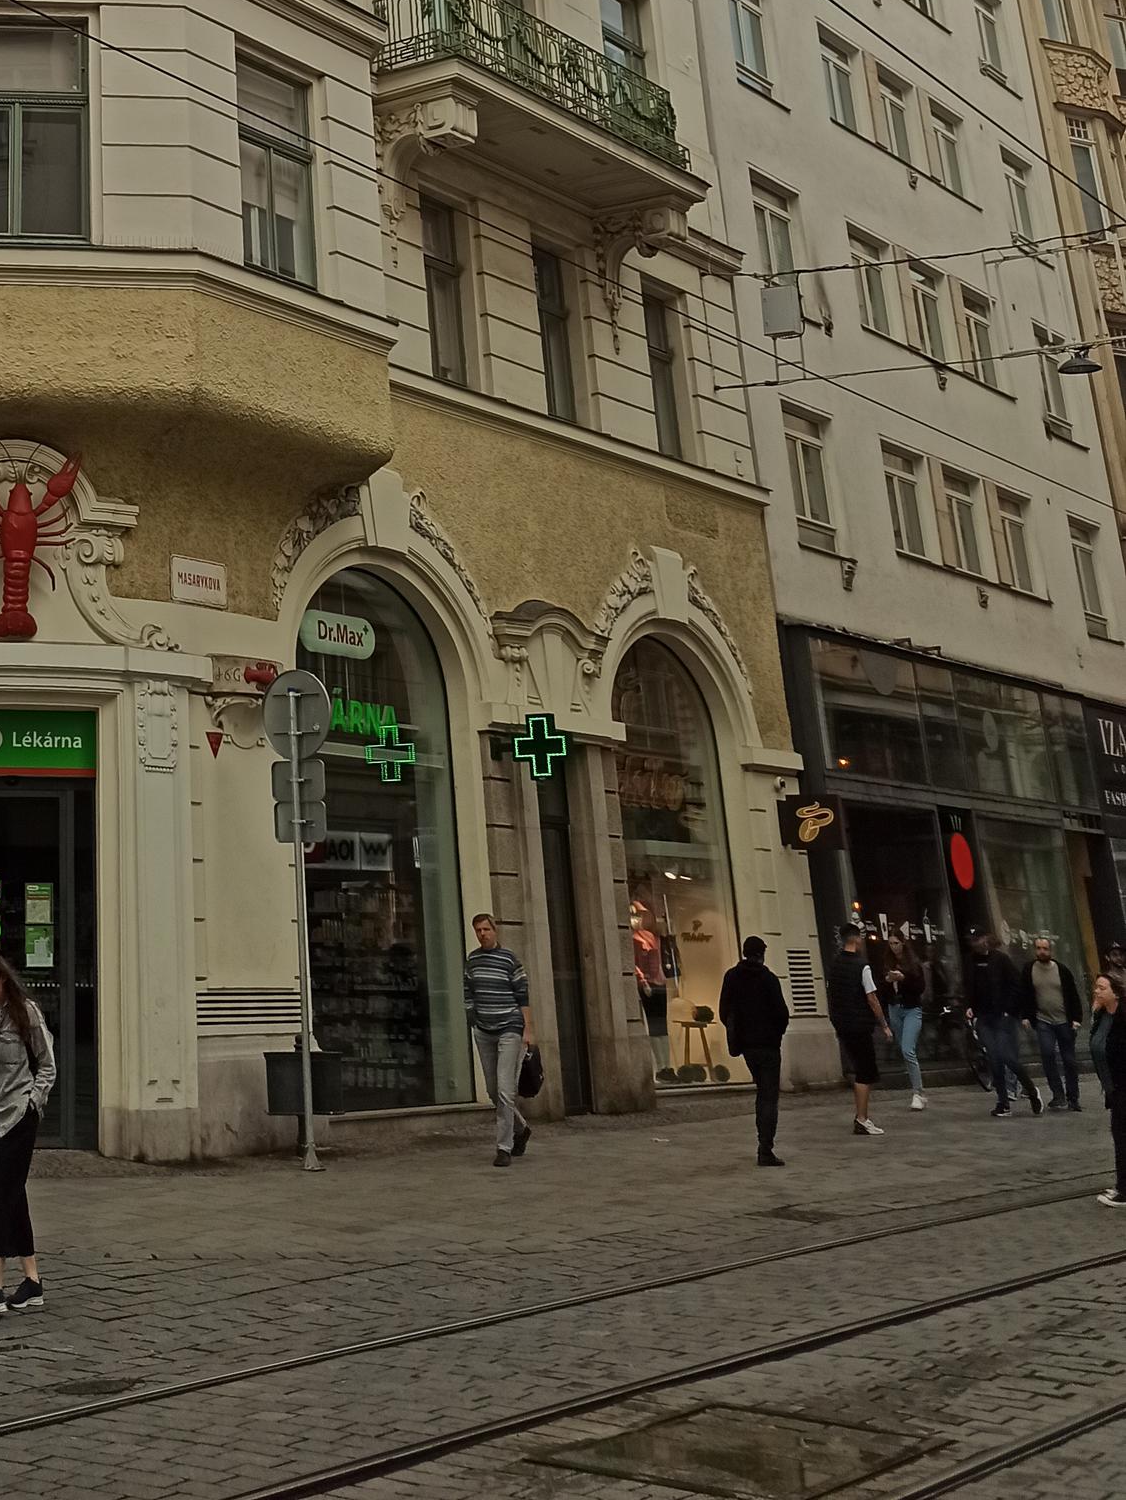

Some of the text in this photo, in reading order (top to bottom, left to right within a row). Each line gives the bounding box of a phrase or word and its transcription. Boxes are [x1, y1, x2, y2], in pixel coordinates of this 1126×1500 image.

[177, 571, 221, 591] MASARYKOVA
[317, 619, 364, 647] Dr.Max
[330, 686, 398, 737] ÁRNA
[12, 731, 82, 749] Lékárna
